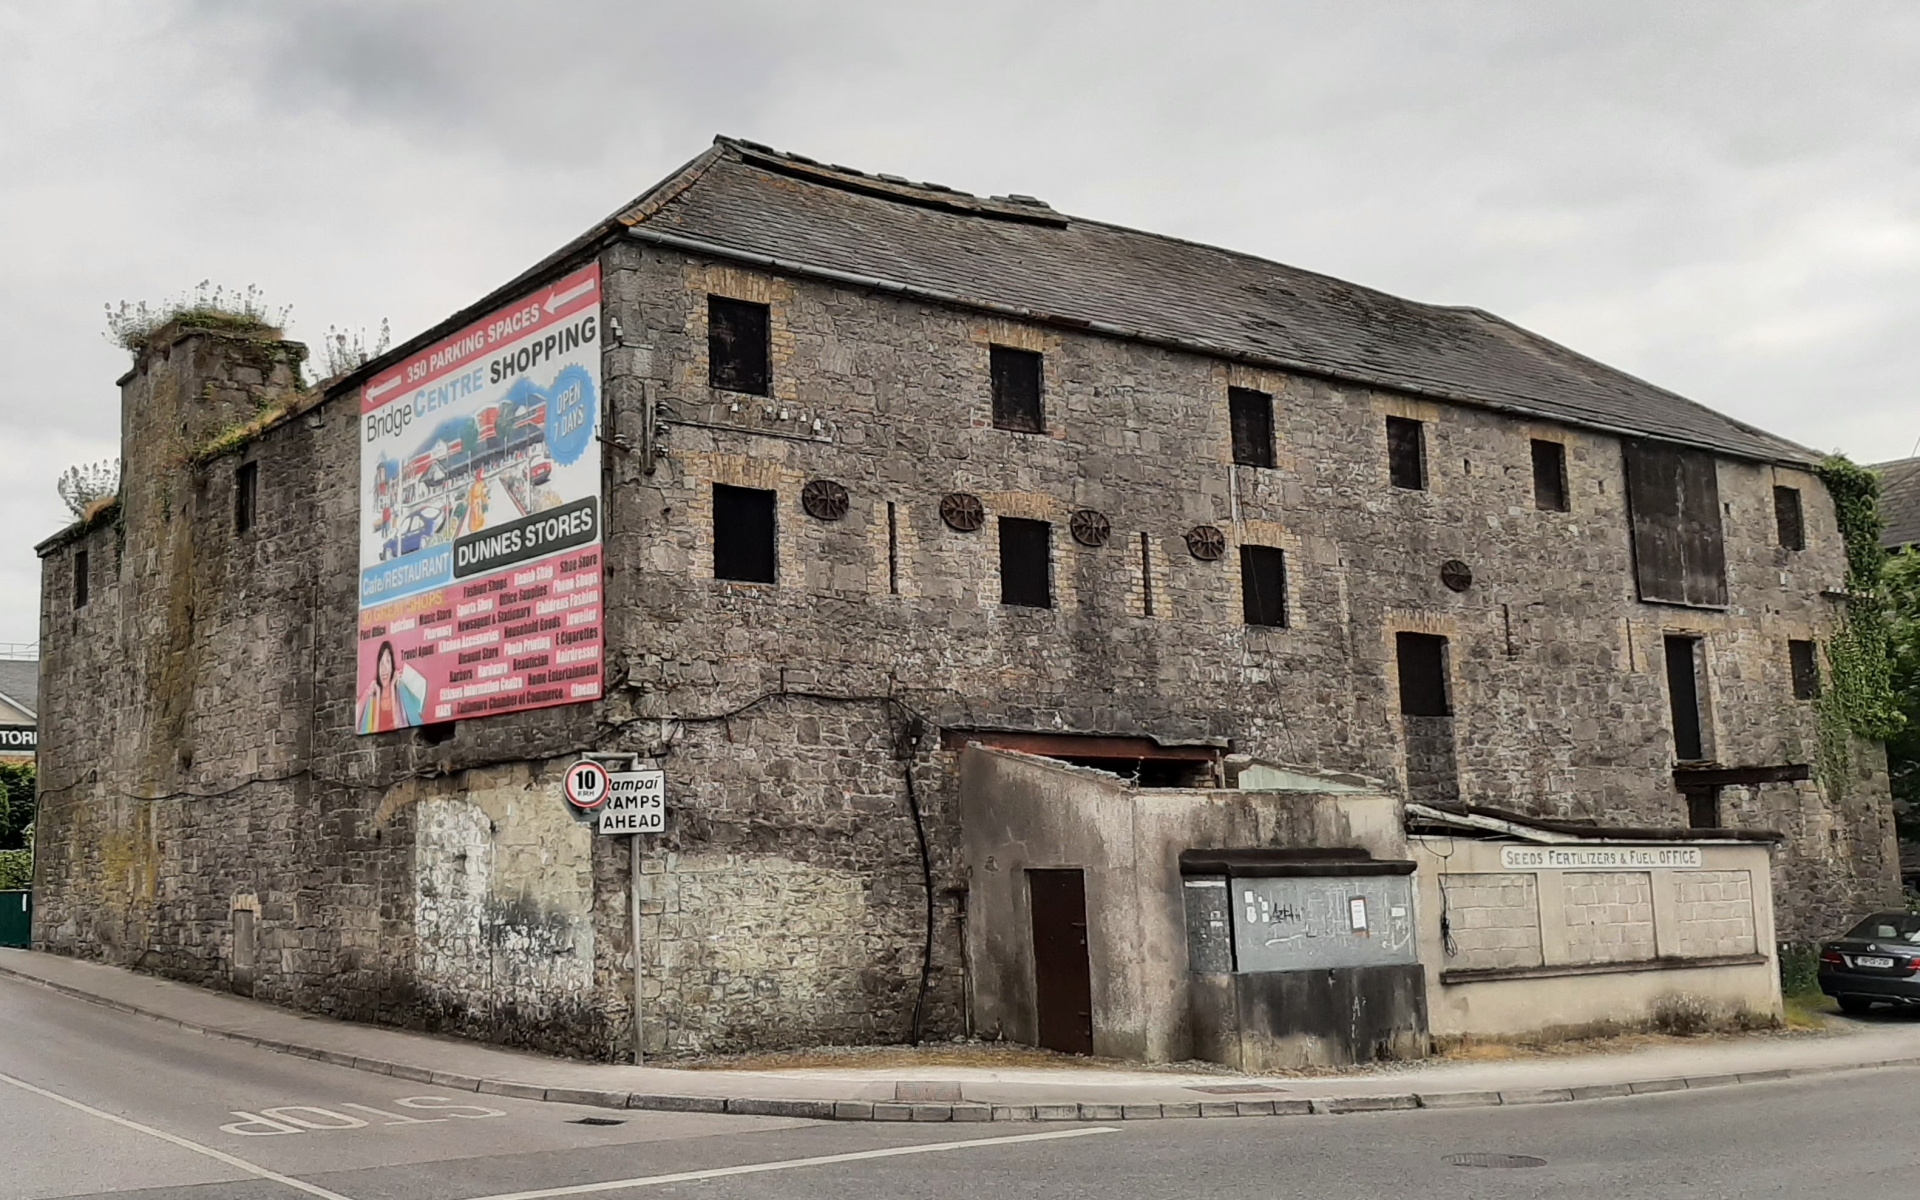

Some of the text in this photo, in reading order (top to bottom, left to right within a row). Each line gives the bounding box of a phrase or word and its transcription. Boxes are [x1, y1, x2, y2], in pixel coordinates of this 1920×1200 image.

[407, 304, 540, 383] 350 PARKING SPACES
[490, 316, 596, 384] SHOPPING
[557, 380, 580, 414] OPEN
[554, 404, 584, 441] 7 DAYS
[458, 508, 592, 566] DUNNES STORES
[362, 610, 372, 624] 30
[374, 602, 402, 620] GREAT
[409, 590, 442, 611] SHOPS
[464, 582, 487, 598] Fashion
[488, 578, 507, 593] Shops
[578, 554, 598, 568] Store
[437, 609, 452, 621] Store
[457, 602, 476, 617] Sports
[478, 598, 493, 611] Shop
[499, 592, 518, 606] Office
[519, 585, 548, 601] Supplies
[553, 578, 574, 594] Phone
[576, 572, 598, 588] Shops
[458, 614, 490, 632] Newsagent
[570, 590, 598, 606] Fashion
[505, 620, 538, 638] Household
[482, 647, 498, 660] Store
[504, 642, 522, 656] Photo
[524, 636, 550, 652] Printing
[561, 627, 598, 645] Cigarettes
[450, 670, 472, 682] Barbers
[514, 654, 548, 671] Beautician
[556, 645, 598, 664] Hairdresser
[528, 673, 546, 686] Home
[548, 662, 598, 682] Entertainment
[527, 688, 563, 703] Commerce
[576, 770, 596, 789] 10
[604, 814, 661, 829] AHEAD
[1620, 854, 1627, 865] &
[1659, 851, 1696, 864] OFFICE
[219, 1096, 506, 1136] STOP
